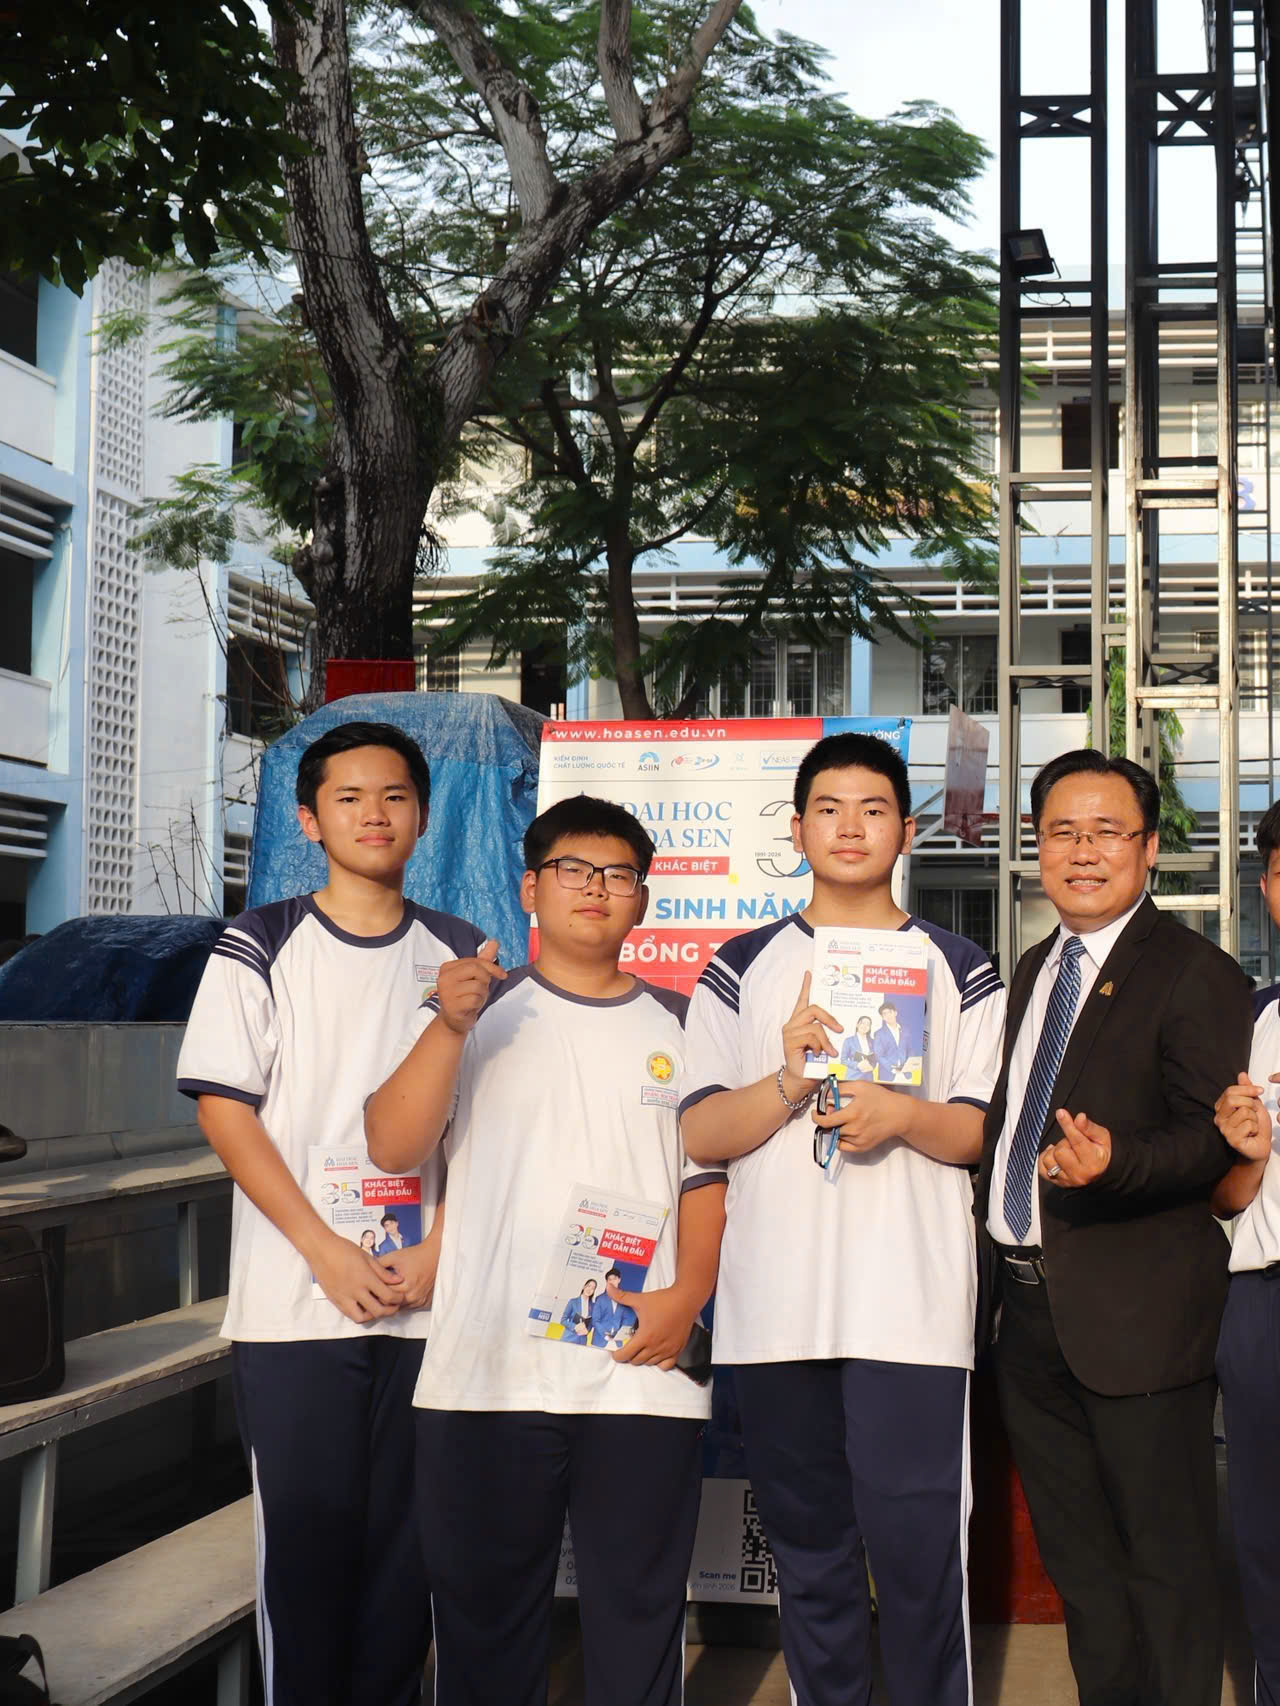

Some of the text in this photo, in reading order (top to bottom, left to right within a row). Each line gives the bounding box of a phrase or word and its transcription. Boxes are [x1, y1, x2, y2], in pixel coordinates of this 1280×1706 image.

[553, 727, 727, 739] www.hoasen.edu.vn
[638, 764, 660, 772] ASIIN
[671, 801, 733, 823] HỌC
[682, 828, 733, 848] SEN
[655, 858, 718, 874] KHÁC BIỆT
[656, 892, 806, 920] SINH NĂM
[619, 935, 699, 963] BỔNG
[865, 967, 909, 977] KHÁC BIỆT
[364, 1180, 405, 1188] KHÁC BIỆT
[604, 1231, 642, 1248] KHÁC BIỆT
[699, 1570, 721, 1580] Scan
